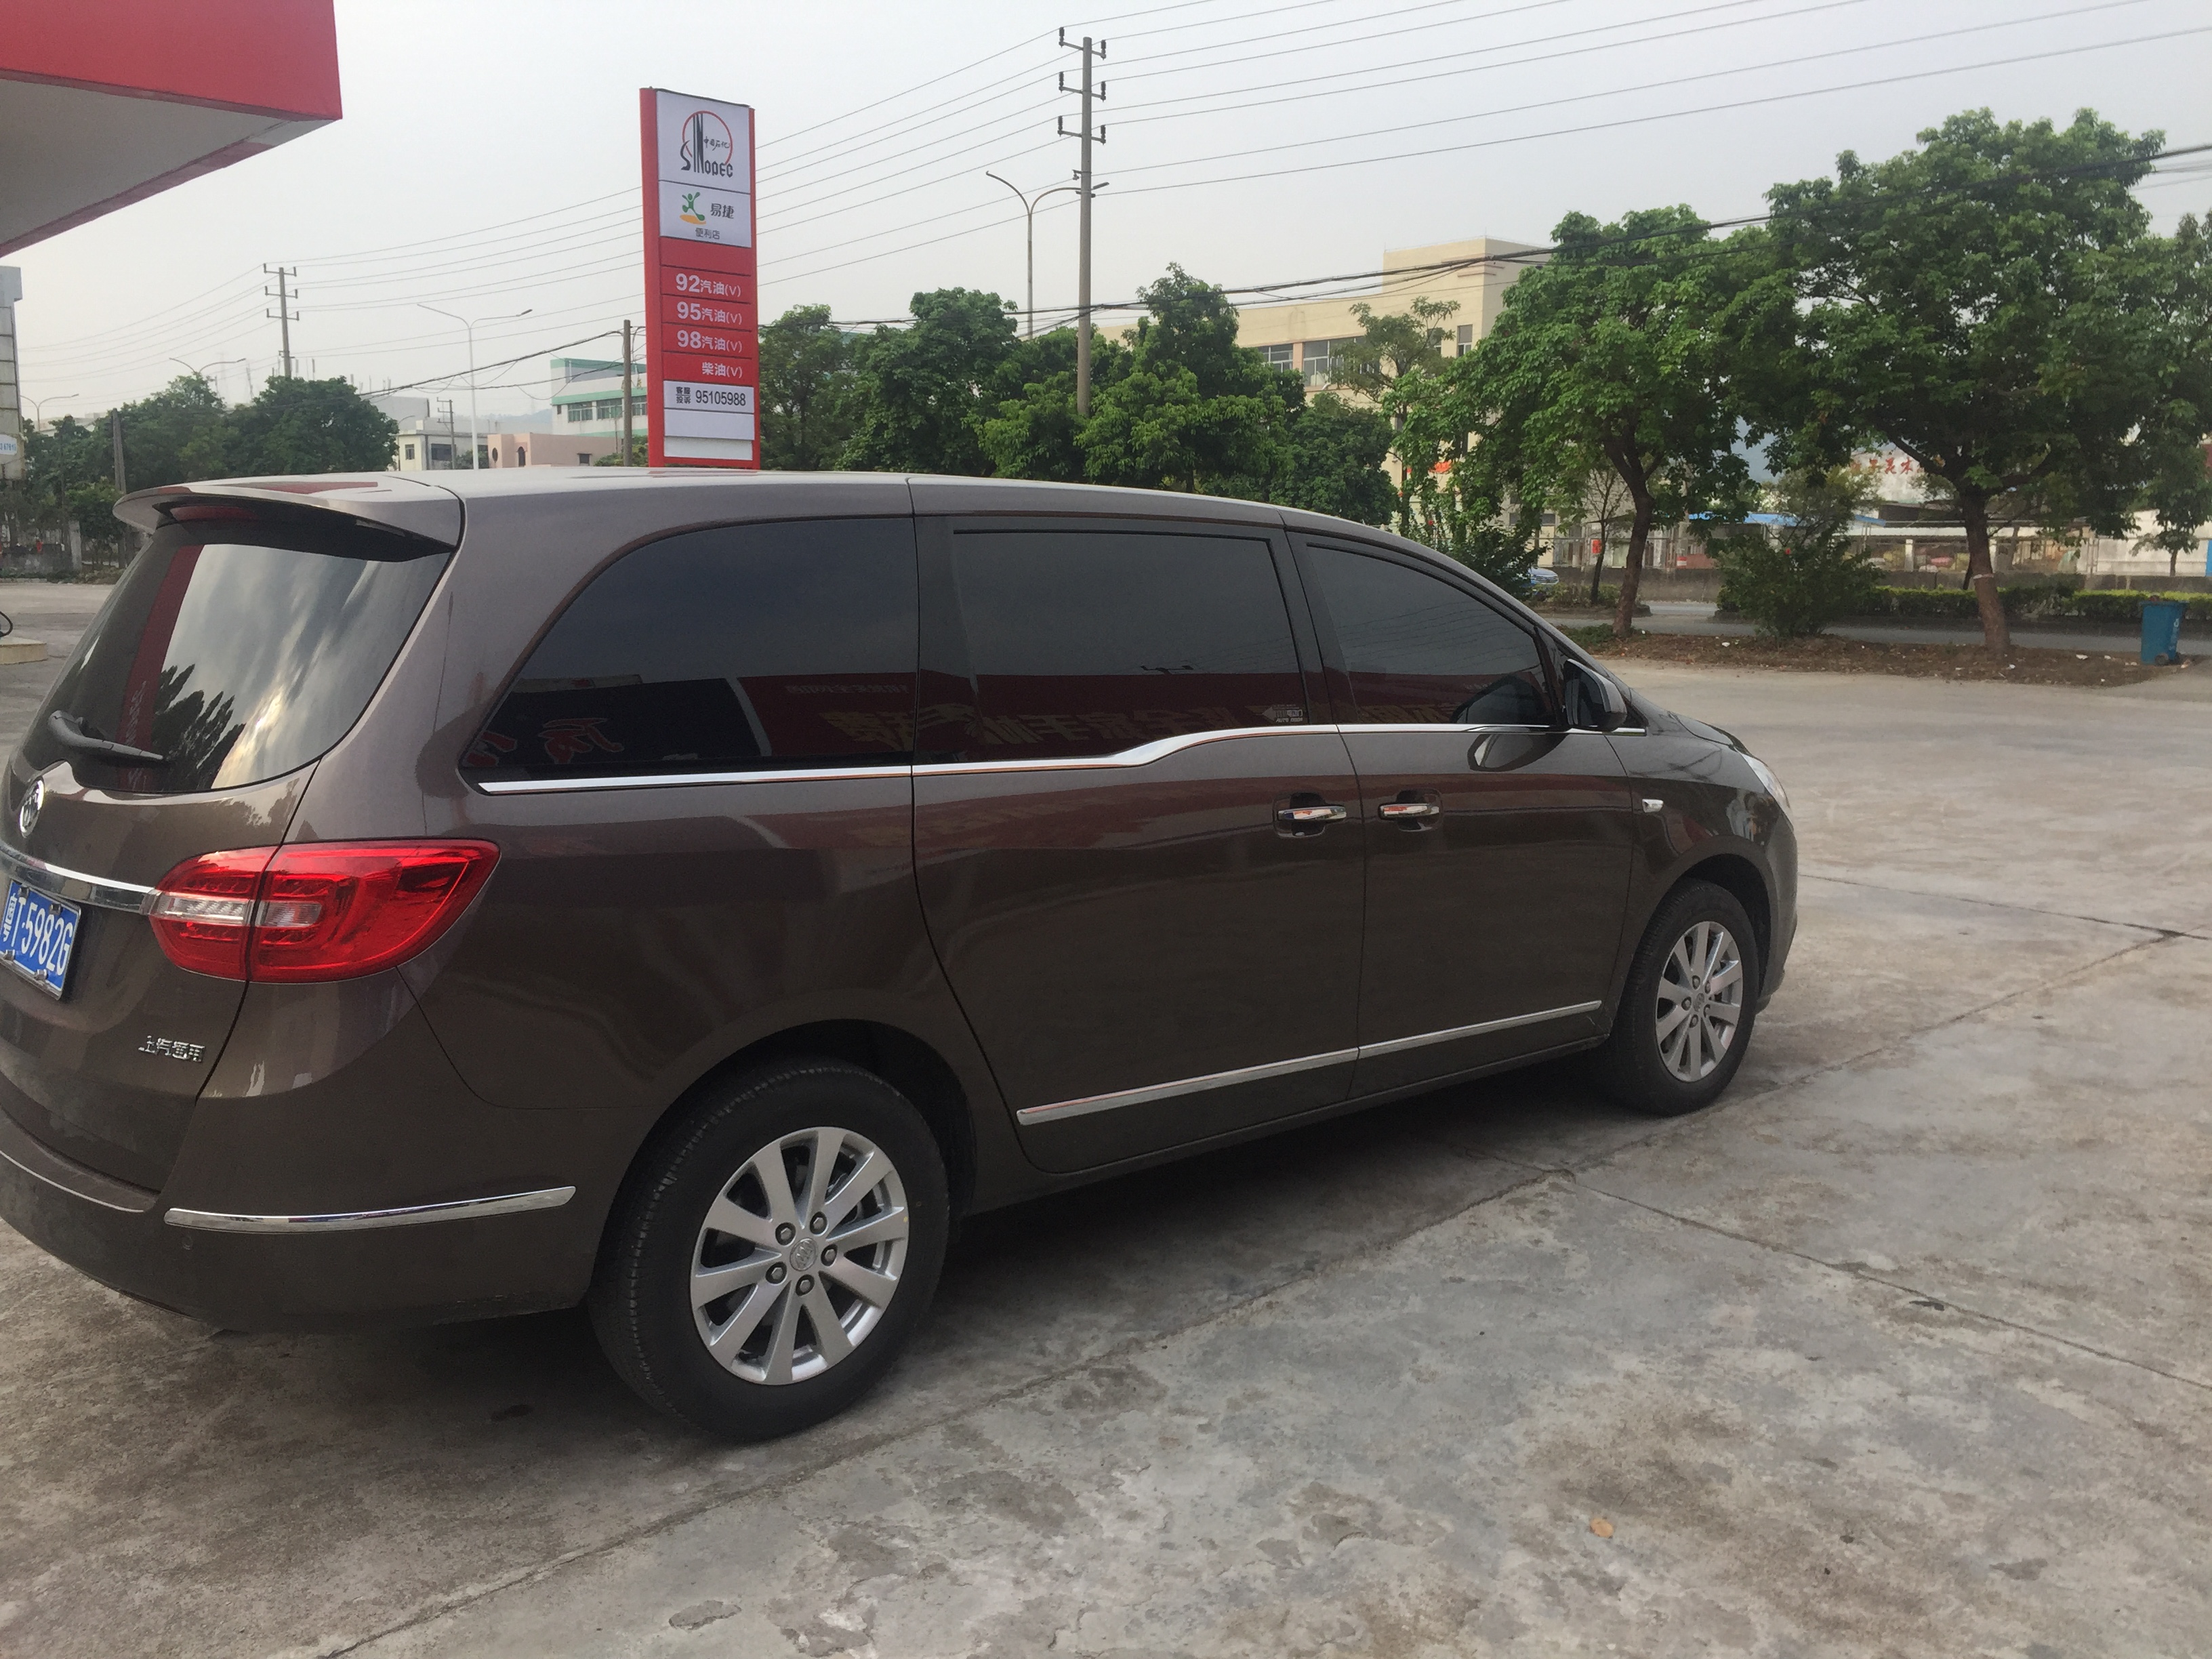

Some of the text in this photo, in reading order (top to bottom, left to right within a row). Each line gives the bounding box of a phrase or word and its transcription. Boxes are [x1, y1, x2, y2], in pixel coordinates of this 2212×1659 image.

[680, 113, 733, 178] SINOPEC
[710, 203, 734, 219] 易捷
[695, 227, 720, 240] 便利店
[701, 362, 743, 379] 柴油(V)
[695, 390, 746, 406] 95105988
